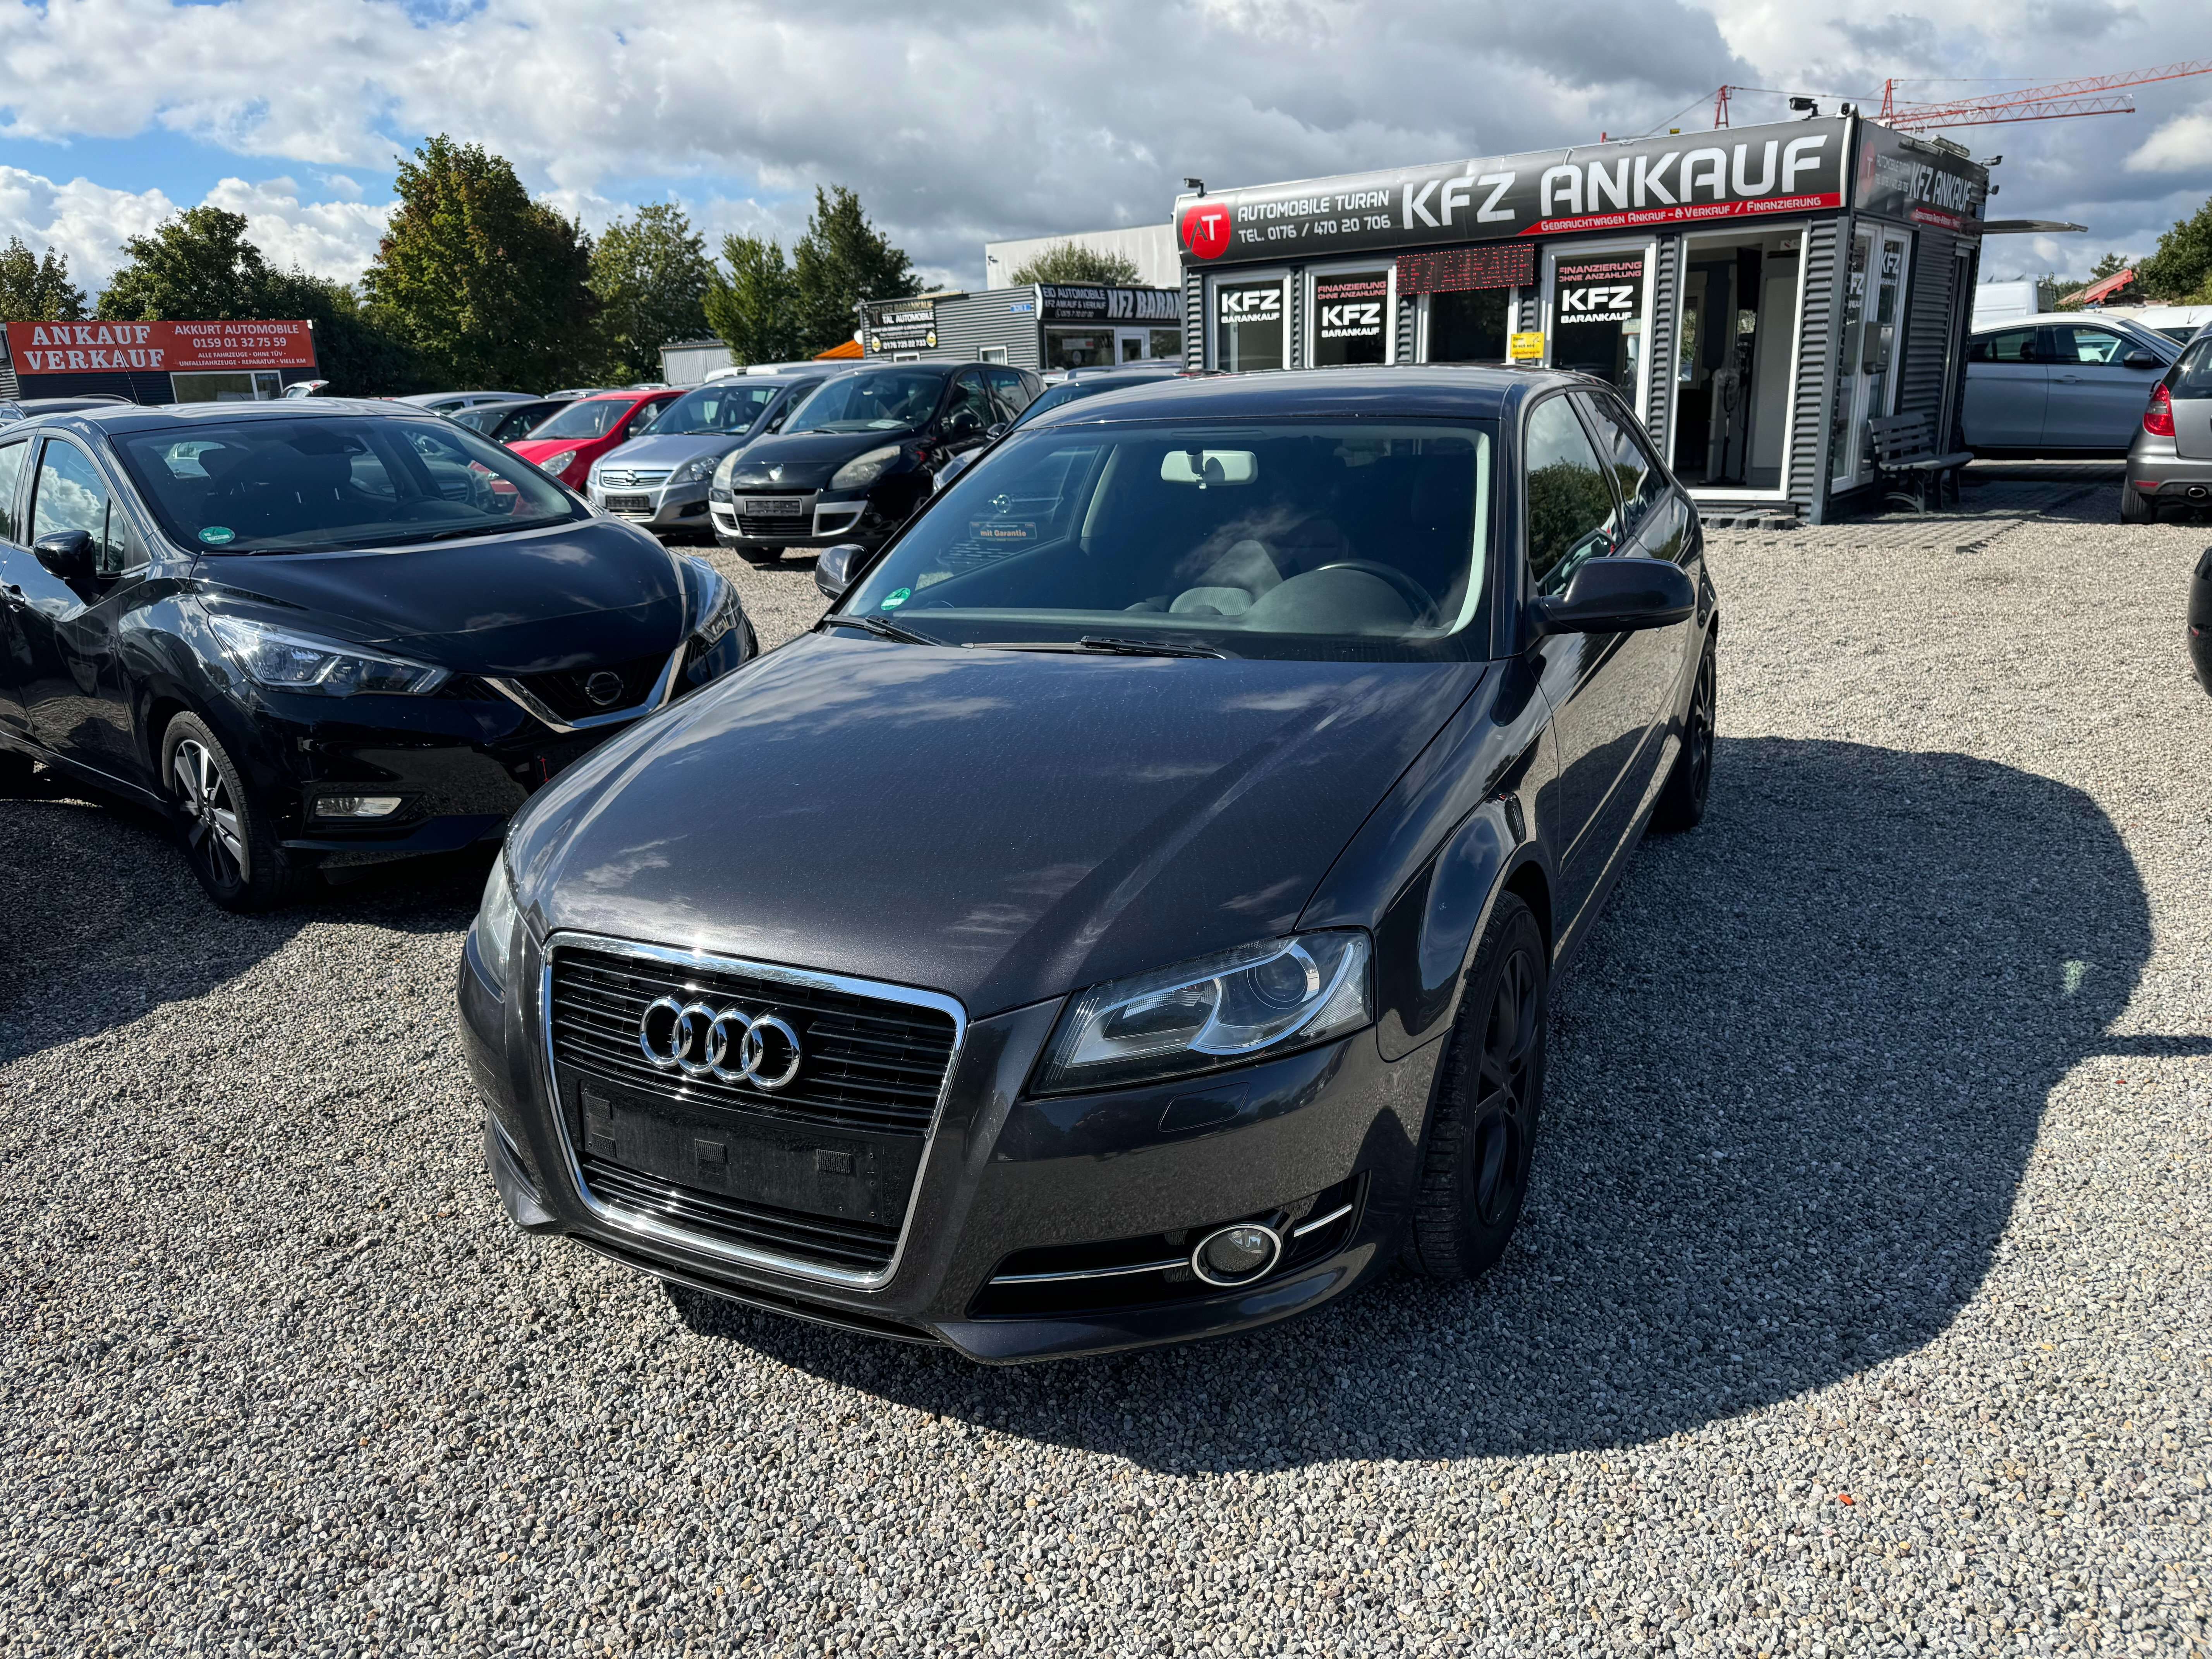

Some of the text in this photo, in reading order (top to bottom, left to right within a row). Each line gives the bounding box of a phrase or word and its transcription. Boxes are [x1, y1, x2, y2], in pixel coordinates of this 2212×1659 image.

[1403, 134, 1827, 230] KFZ ANKAUF
[1909, 162, 1972, 212] KFZ ANKAUF
[1238, 190, 1389, 222] AUTOMOBILE TURAN
[1238, 228, 1265, 243] TEL.
[1268, 225, 1297, 240] 0176
[1314, 220, 1337, 235] 470
[1341, 218, 1360, 233] 20
[1364, 214, 1391, 230] 706
[1559, 261, 1643, 274] FINANZIERUNG
[1585, 270, 1642, 280] ANZAHLUNG
[1317, 281, 1386, 293] FINANZIERUNG
[1058, 288, 1106, 300] AUTOMOBILE
[1340, 290, 1386, 299] ANZAHLUNG
[1562, 285, 1633, 311] KFZ
[1107, 290, 1133, 318] KFZ
[1221, 289, 1280, 313] KFZ
[882, 312, 934, 325] TAL AUTOMOBILE
[1221, 312, 1280, 323] BARANKAUF
[1322, 303, 1380, 327] KFZ
[1561, 311, 1632, 324] BARANKAUF
[32, 326, 150, 345] ANKAUF
[175, 325, 299, 335] AKKURT AUTOMOBILE
[1321, 327, 1380, 338] BARANKAUF
[193, 337, 287, 348] 0159 01 32 75 59
[23, 349, 164, 369] VERKAUF
